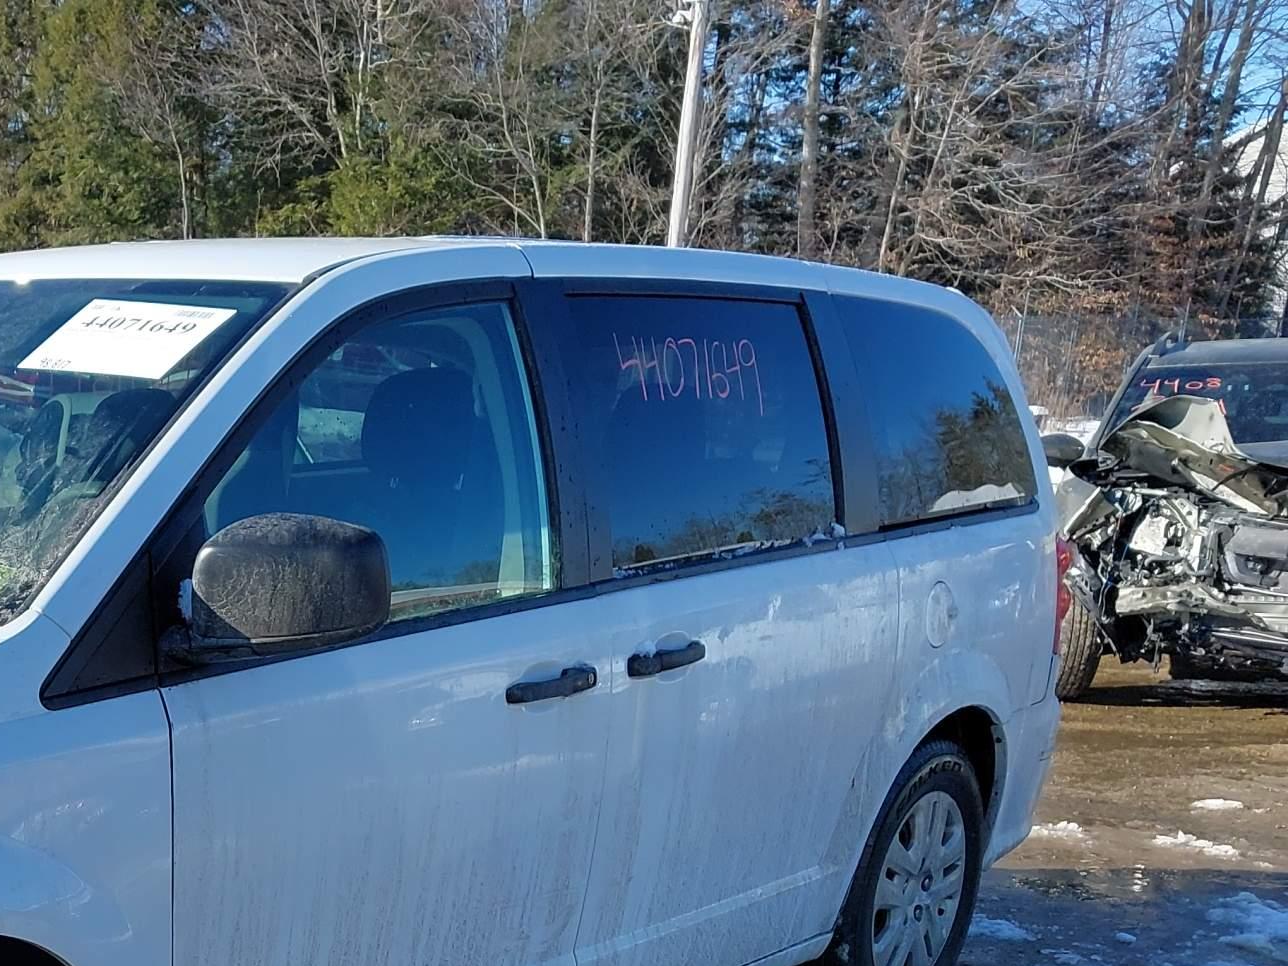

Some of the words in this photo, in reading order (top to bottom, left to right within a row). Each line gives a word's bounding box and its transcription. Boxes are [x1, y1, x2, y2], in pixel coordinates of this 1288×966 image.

[81, 315, 197, 334] 44071649
[612, 332, 763, 416] 44071649
[1140, 377, 1222, 394] 4408
